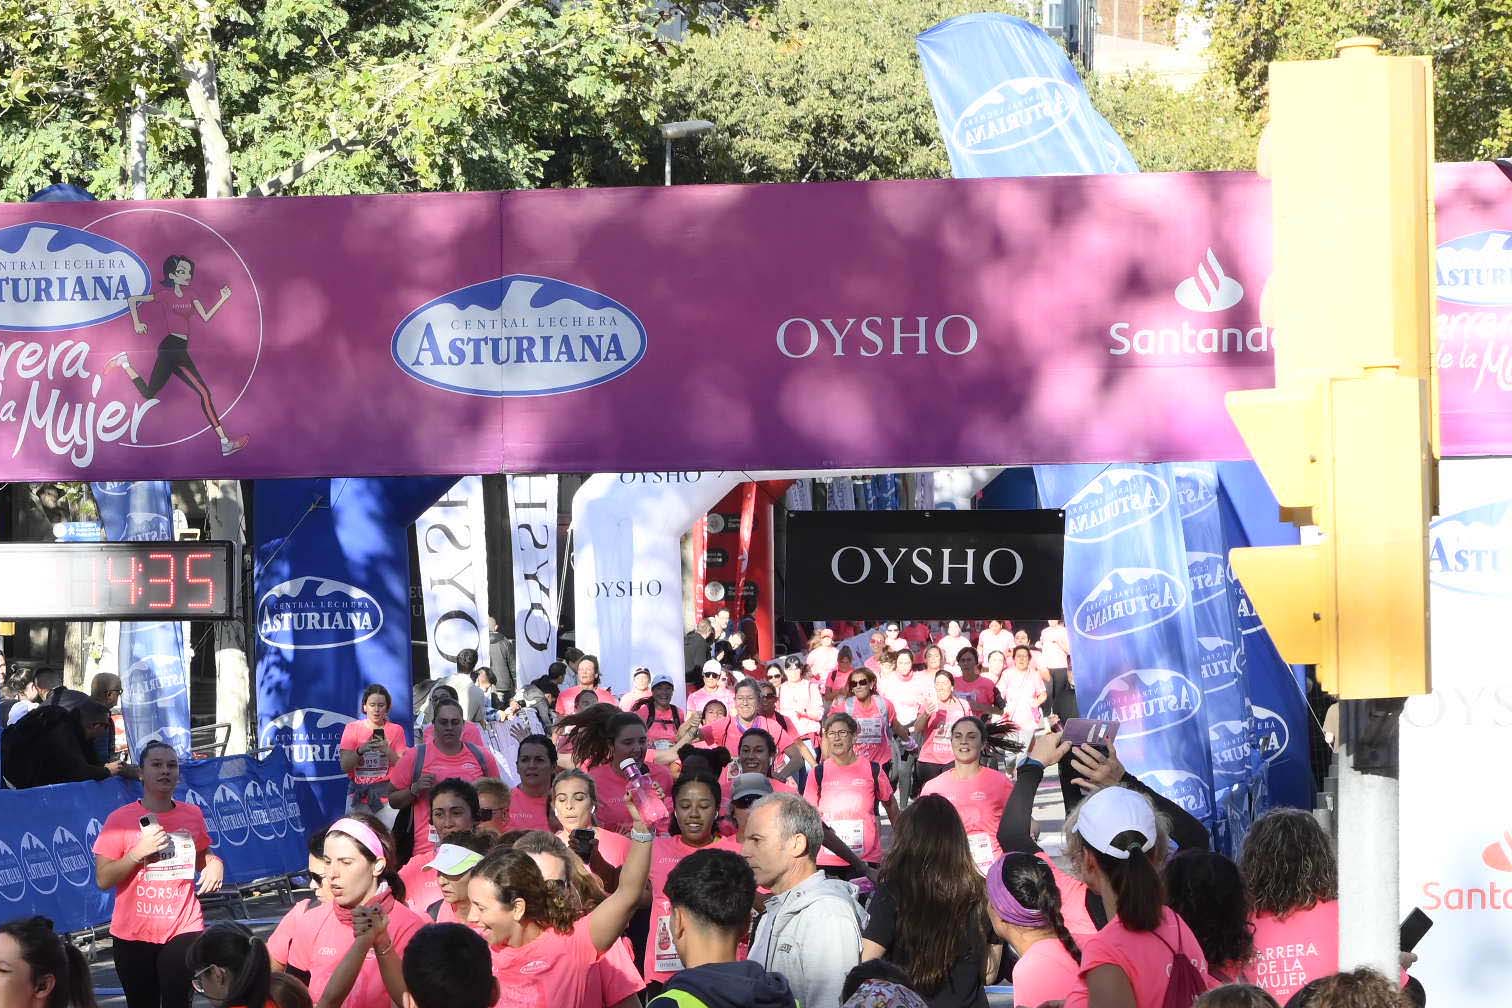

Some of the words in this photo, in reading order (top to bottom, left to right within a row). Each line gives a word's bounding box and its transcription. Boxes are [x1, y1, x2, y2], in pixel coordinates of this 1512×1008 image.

[53, 257, 126, 271] LECHERA
[451, 317, 529, 331] CENTRAL
[537, 315, 619, 329] LECHERA
[411, 322, 628, 367] ASTURIANA
[776, 315, 979, 358] OYSHO
[1109, 322, 1277, 355] Santand
[11, 373, 161, 468] Mujer
[831, 545, 1025, 588] OYSHO
[586, 579, 663, 599] OYSHO
[274, 600, 316, 610] CENTRAL
[320, 600, 369, 610] LECHERA
[261, 605, 374, 634] ASTURIANA
[136, 901, 174, 914] SUMA
[1257, 961, 1278, 976] DE
[1283, 958, 1305, 972] LA
[1256, 972, 1308, 989] MUJER
